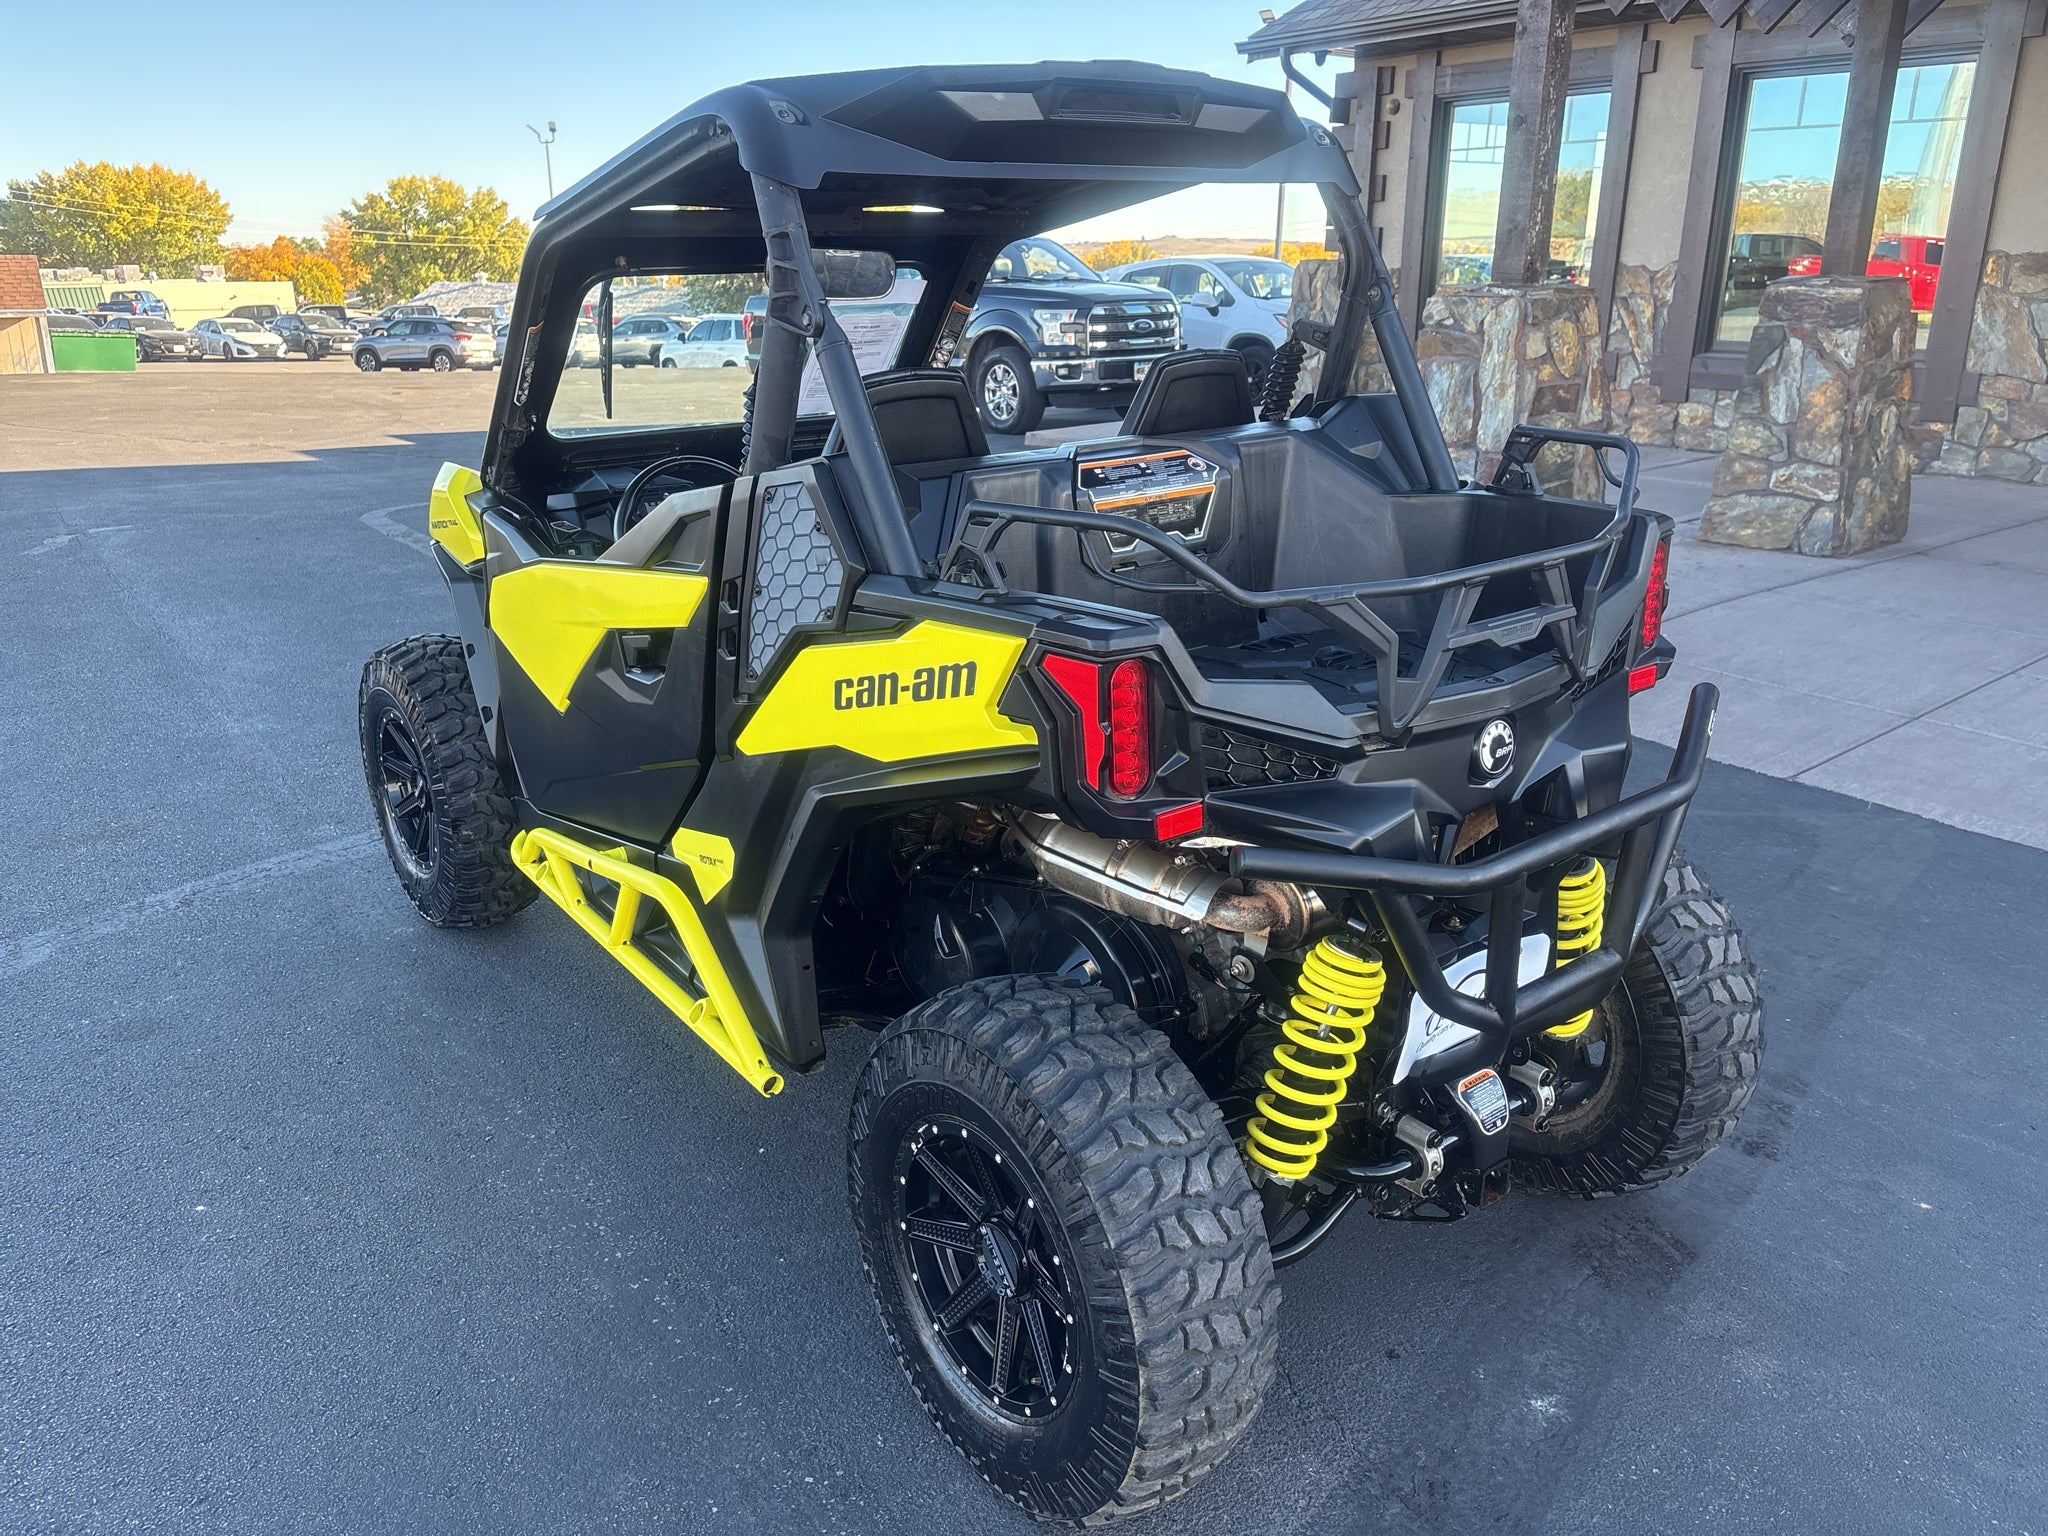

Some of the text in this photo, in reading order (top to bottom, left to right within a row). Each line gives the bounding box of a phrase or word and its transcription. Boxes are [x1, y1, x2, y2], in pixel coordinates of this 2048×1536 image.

[834, 661, 977, 711] can-am
[1495, 744, 1513, 758] BRP
[1467, 1071, 1490, 1086] WARNING
